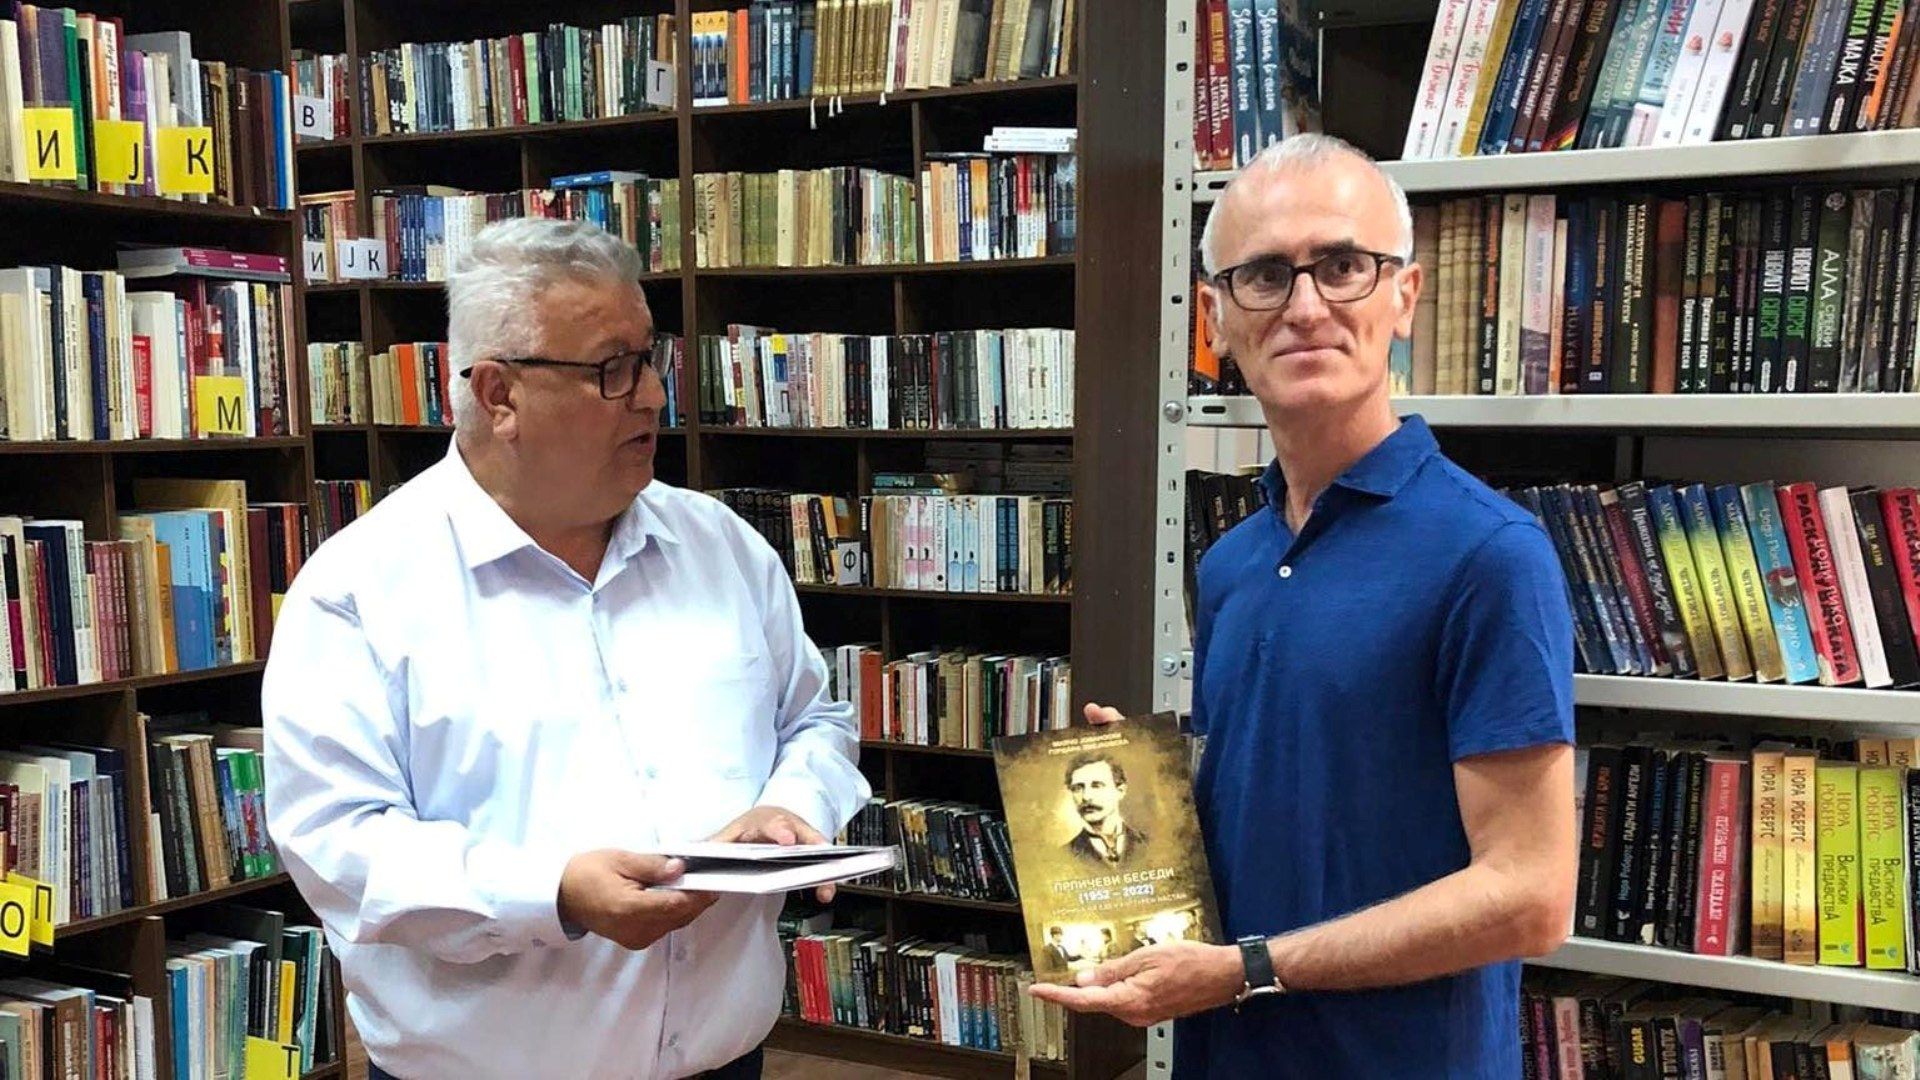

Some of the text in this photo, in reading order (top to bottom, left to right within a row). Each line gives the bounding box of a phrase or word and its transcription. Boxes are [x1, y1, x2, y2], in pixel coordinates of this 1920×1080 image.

[1836, 38, 1866, 85] МАЈКА
[1865, 35, 1891, 82] МАЈКА
[656, 68, 667, 91] Г
[303, 106, 314, 127] В
[36, 130, 60, 169] И
[128, 143, 138, 180] Ј
[187, 138, 209, 175] К
[311, 252, 325, 272] И
[347, 248, 355, 268] Ј
[368, 250, 381, 272] К
[1763, 250, 1784, 294] НОВИОТ
[1790, 247, 1812, 292] НОВИОТ
[1819, 248, 1840, 300] АЈЛА
[1760, 298, 1782, 339] СОПРУГ
[1785, 296, 1807, 339] СОПРУГ
[217, 396, 242, 431] М
[1631, 507, 1656, 562] Приказна
[843, 540, 857, 571] Ф
[1779, 595, 1804, 649] Заедно
[1865, 750, 1879, 765] НО
[1895, 750, 1909, 766] НО
[1628, 763, 1641, 799] АНГЕЛИ
[1623, 799, 1637, 842] ПАДНАТИ
[1760, 765, 1777, 839] НОРА РОБЕРТС
[1789, 769, 1807, 843] НОРА РОБЕРТС
[1821, 784, 1851, 837] НОРА РОБЕРТС
[1867, 786, 1897, 842] НОРА РОБЕРТС
[1123, 867, 1175, 884] БЕСЕДИ
[1821, 854, 1840, 921] ПРЕДАВСТВА
[1869, 858, 1887, 926] ПРЕДАВСТВА
[0, 900, 25, 938] О
[34, 885, 52, 923] П
[281, 1045, 300, 1078] Т
[1631, 1026, 1645, 1065] GUSAR
